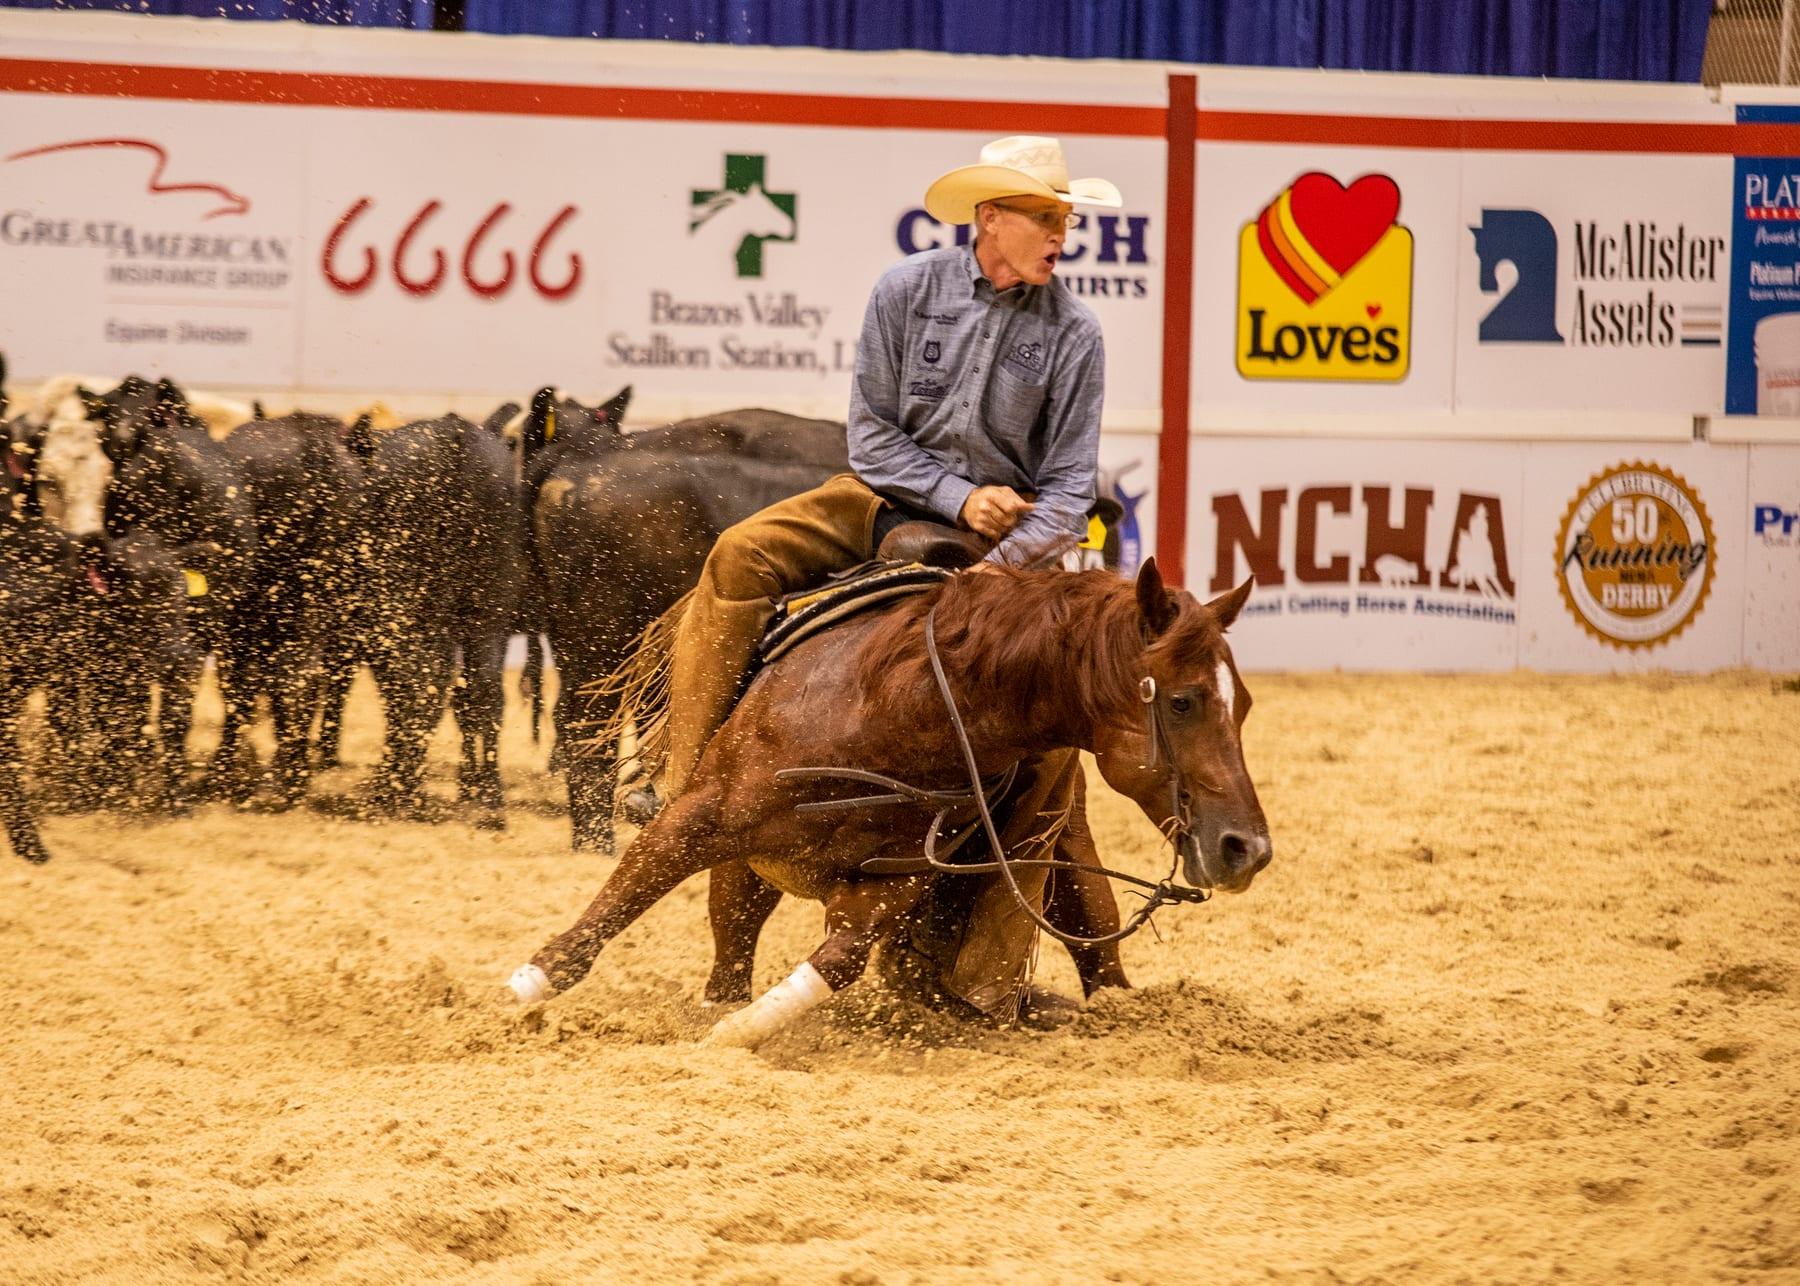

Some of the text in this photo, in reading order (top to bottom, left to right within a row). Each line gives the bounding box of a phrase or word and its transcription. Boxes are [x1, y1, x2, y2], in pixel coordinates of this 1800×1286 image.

[321, 196, 584, 300] 6666
[896, 205, 1150, 264] CCH
[1573, 219, 1725, 282] McAlister
[1063, 276, 1147, 298] IRTS
[105, 316, 168, 343] Equine
[745, 291, 829, 340] Valley
[1571, 287, 1675, 347] Assets
[605, 332, 711, 370] Stallion
[1209, 482, 1516, 597] NCHA
[1562, 531, 1708, 582] Running
[1288, 593, 1350, 615] Cutting
[1414, 596, 1516, 624] Association
[1602, 582, 1672, 610] DERBY
